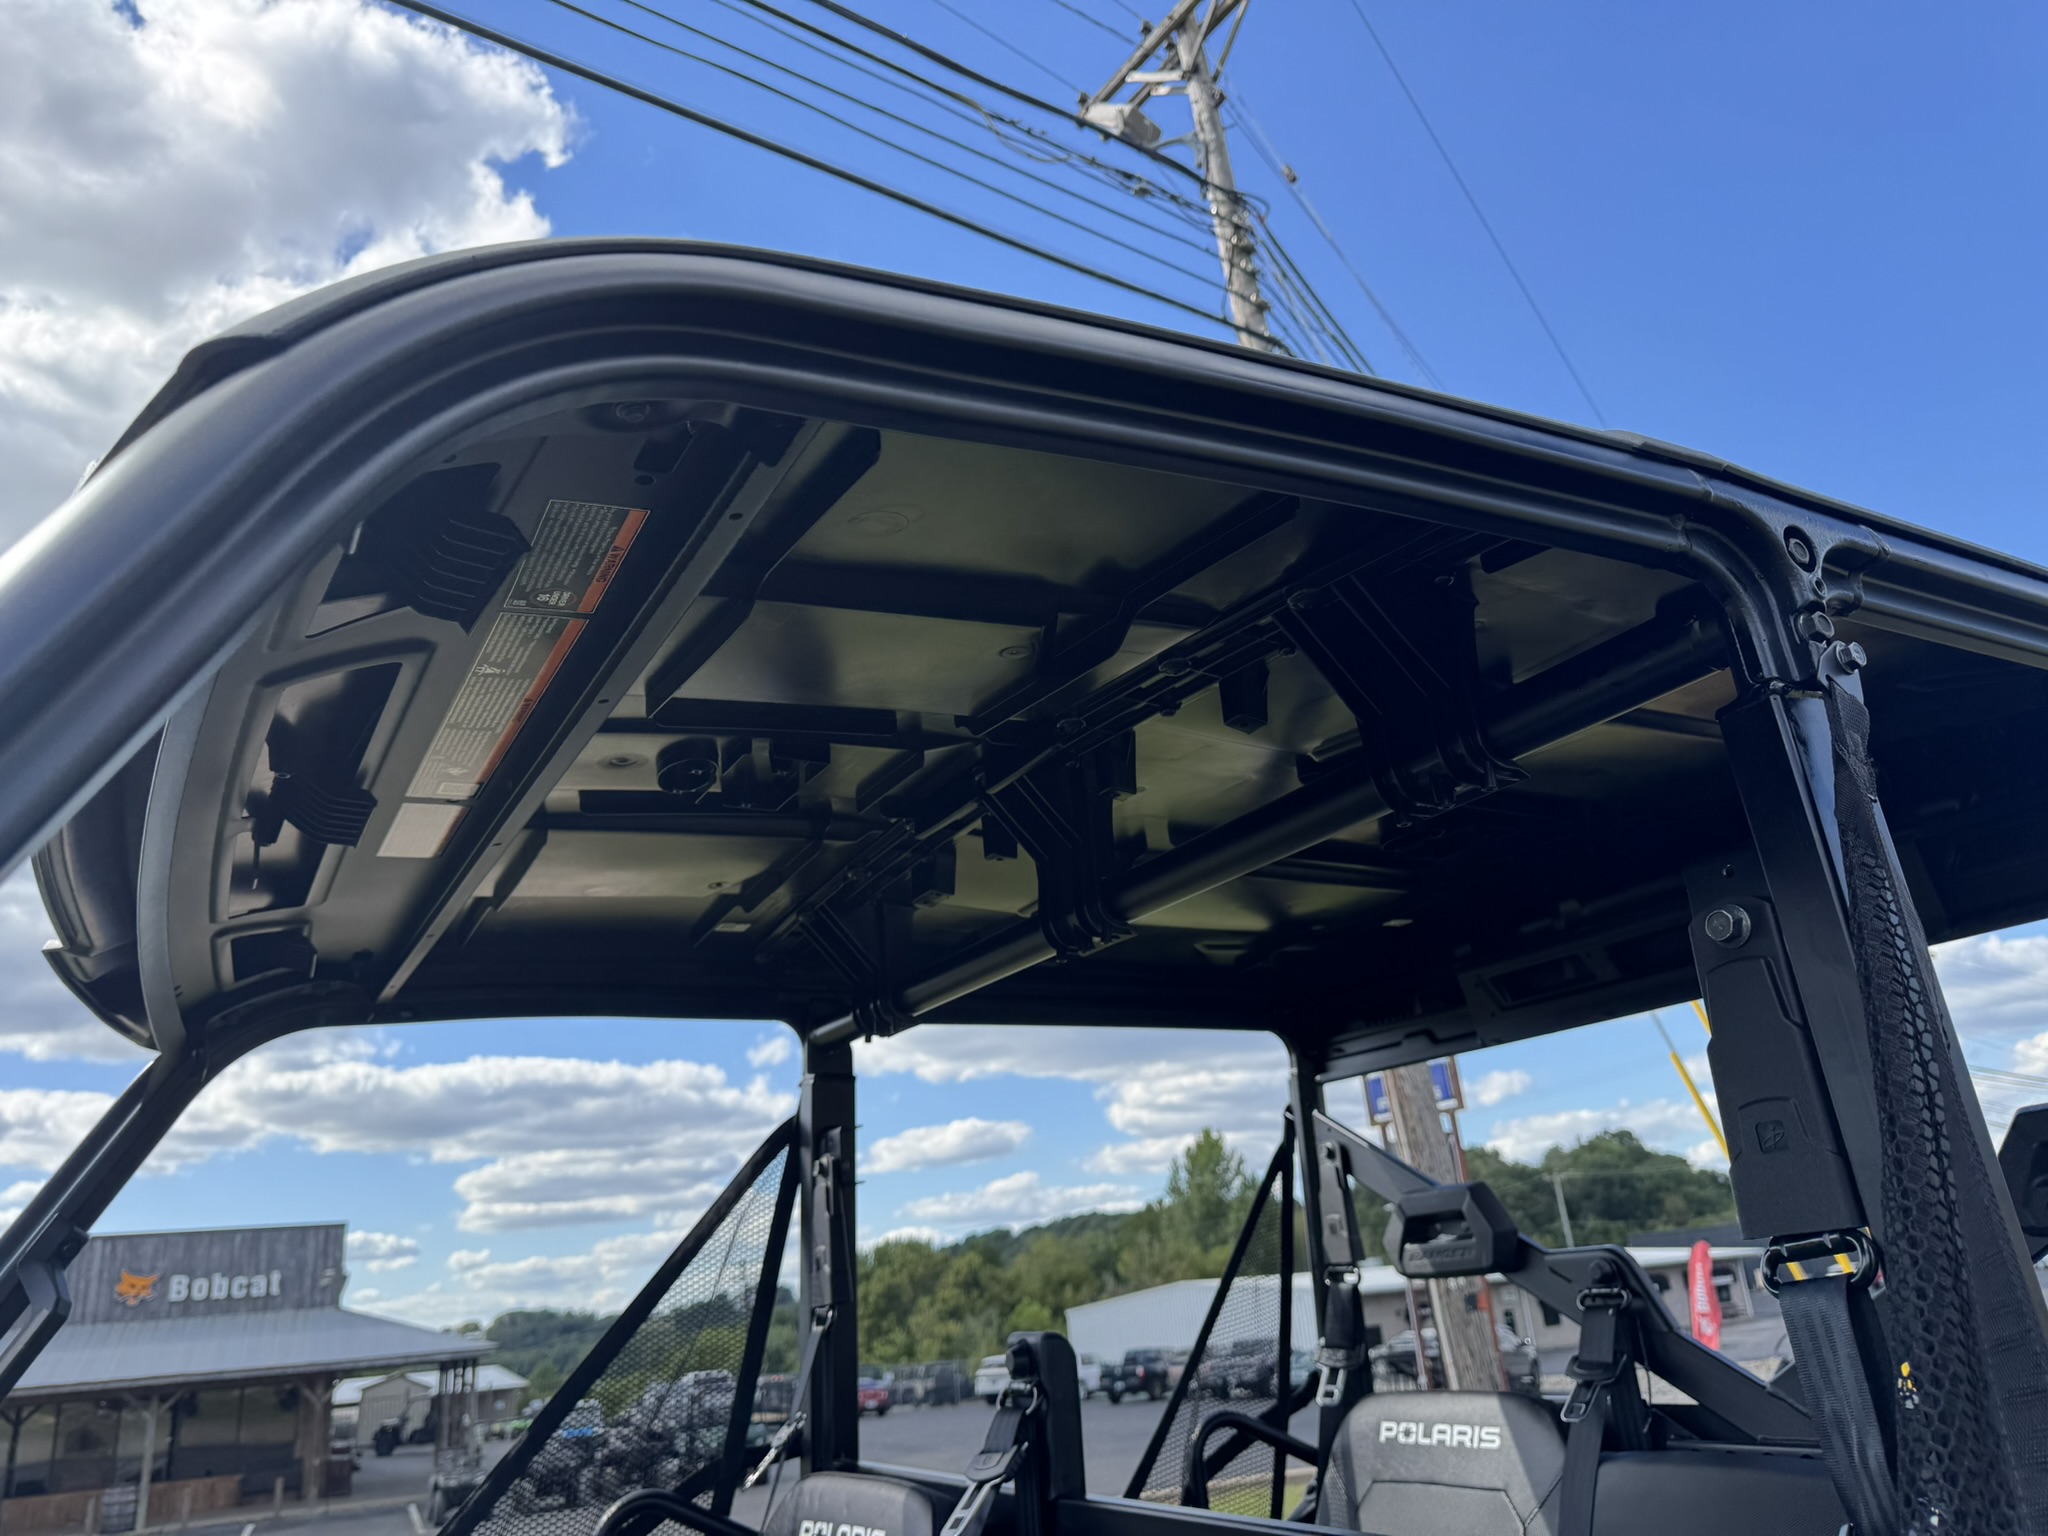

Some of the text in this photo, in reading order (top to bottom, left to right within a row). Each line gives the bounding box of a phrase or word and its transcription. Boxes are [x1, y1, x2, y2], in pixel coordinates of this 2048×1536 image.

[595, 552, 621, 583] WARNING
[536, 593, 551, 602] 16
[547, 590, 561, 606] UNDER
[556, 591, 572, 607] DRIVER
[168, 1269, 282, 1302] Bobcat
[1379, 1420, 1501, 1450] POLARIS
[799, 1519, 887, 1536] POLA
